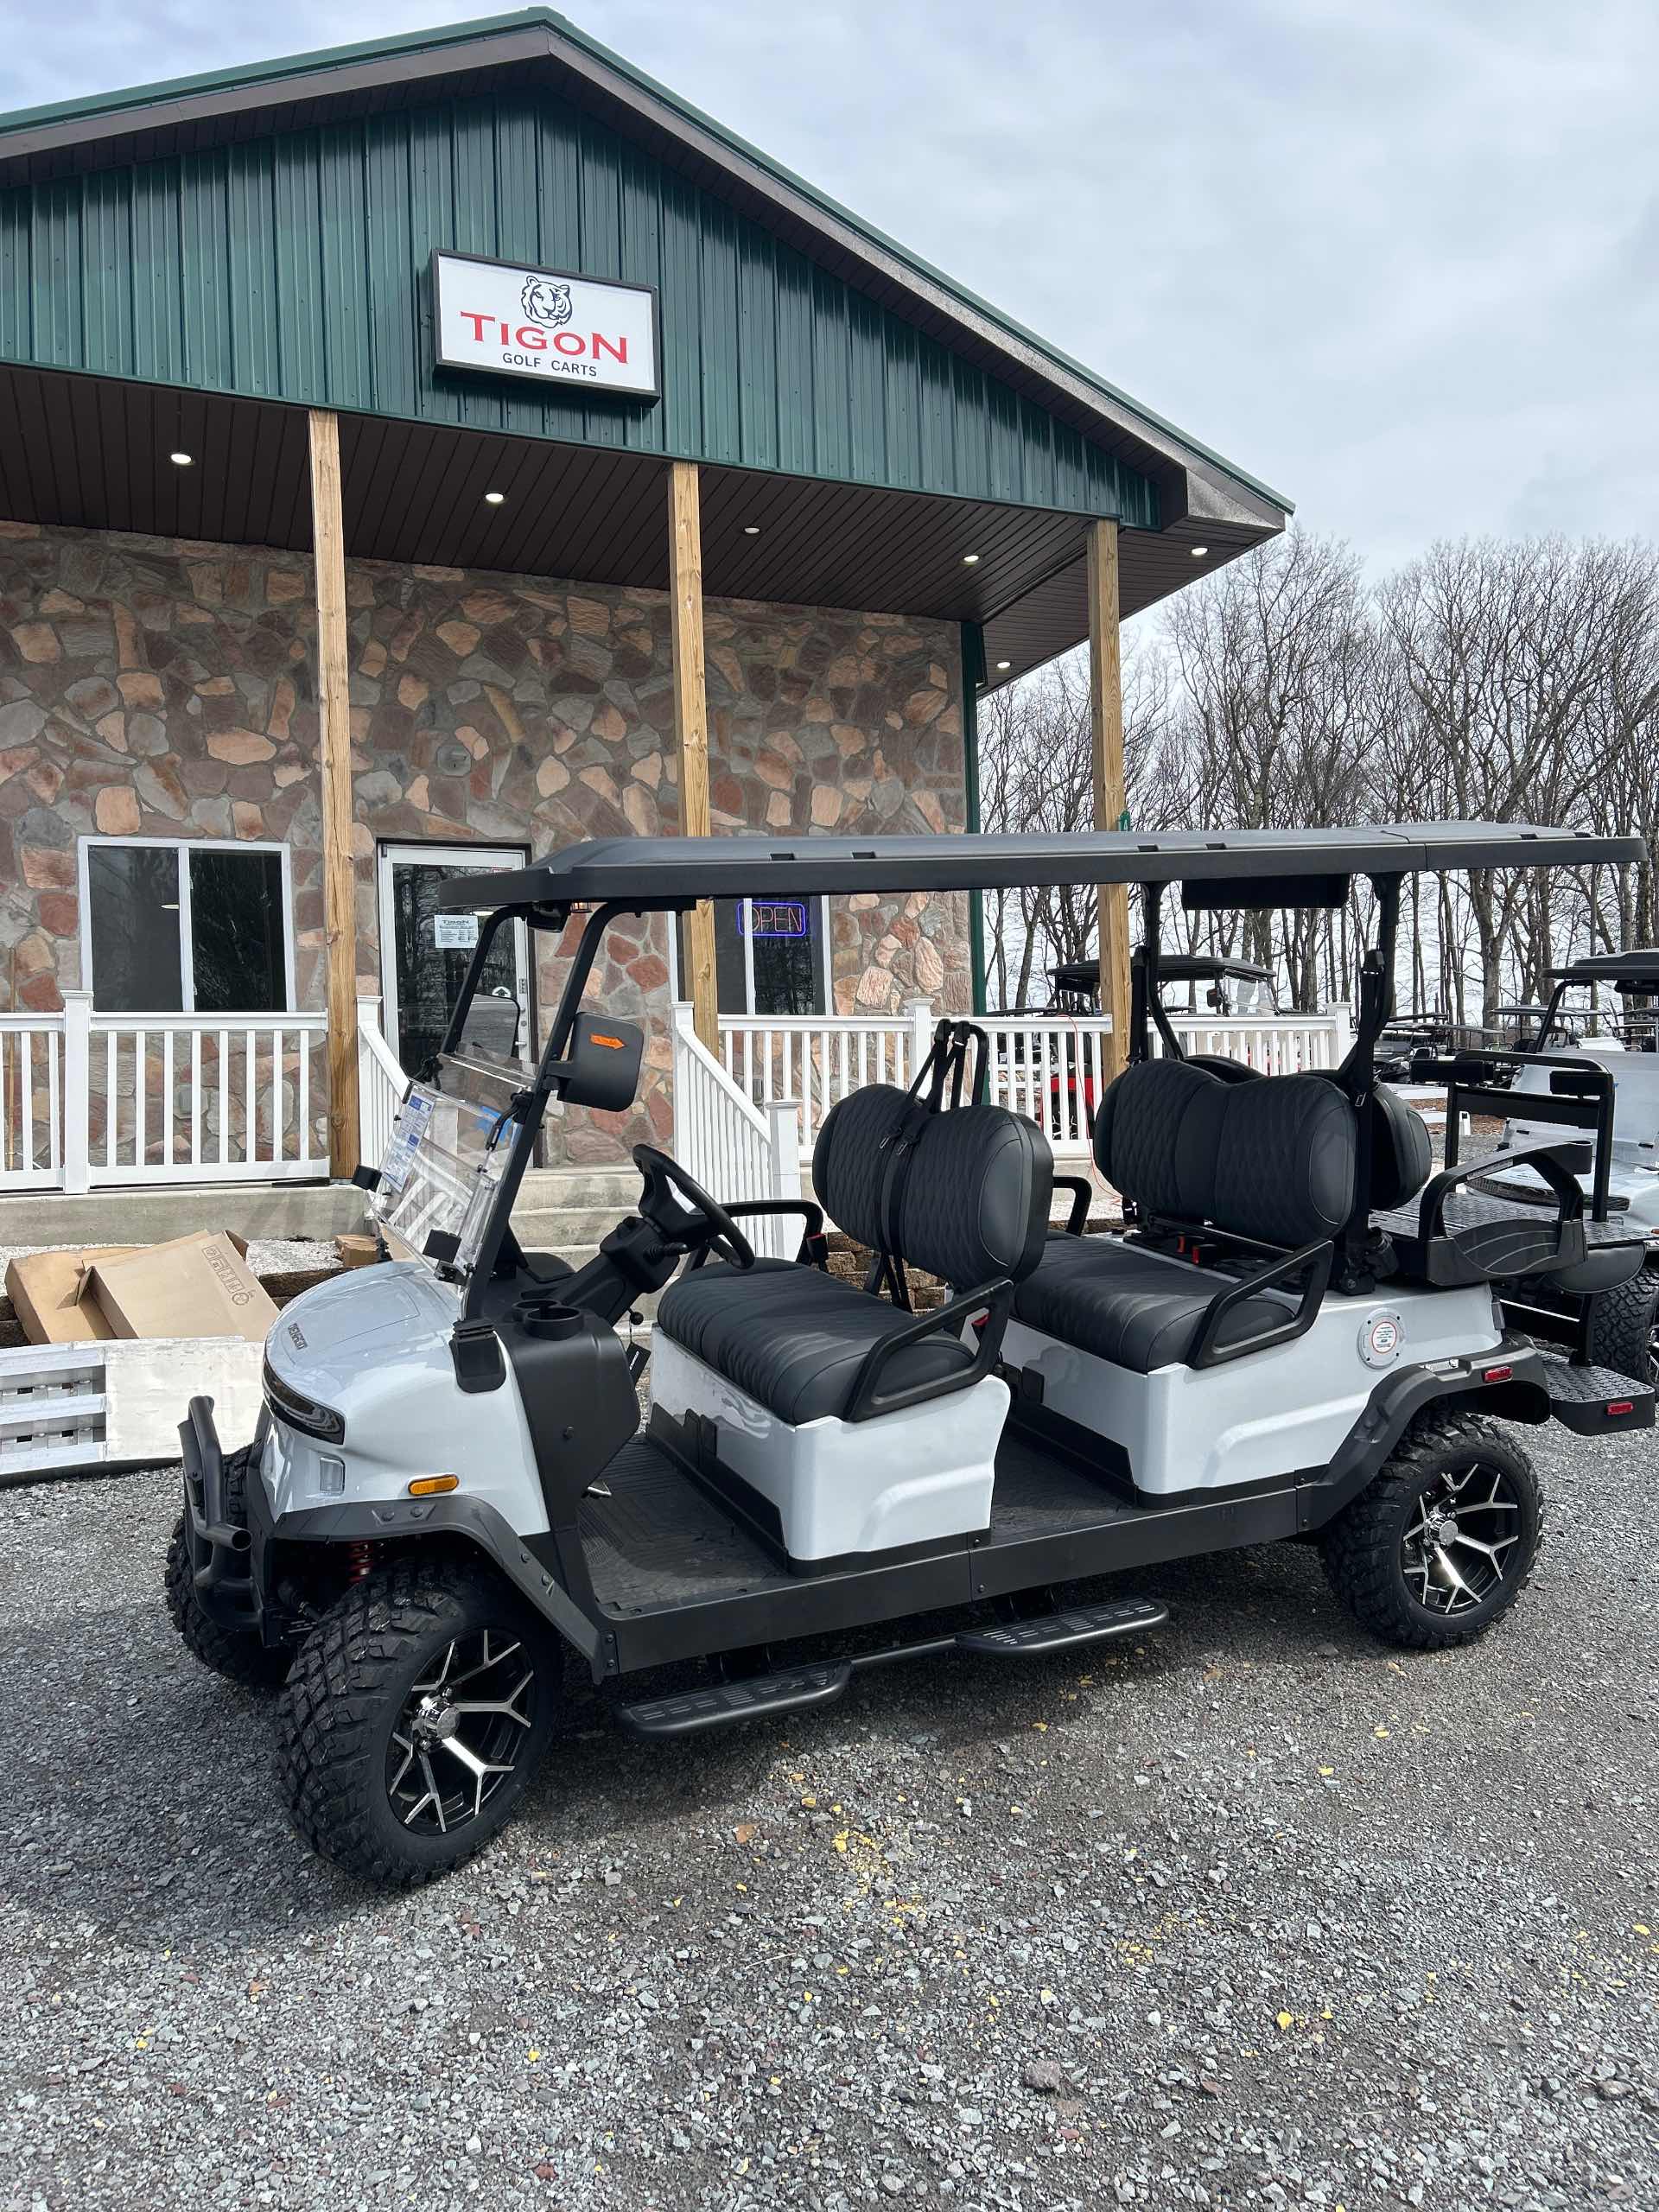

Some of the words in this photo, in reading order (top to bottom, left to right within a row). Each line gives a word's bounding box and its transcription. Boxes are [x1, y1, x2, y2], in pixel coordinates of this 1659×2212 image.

[460, 311, 629, 364] TIGON
[502, 353, 541, 368] GOLF
[551, 359, 597, 377] CARTS
